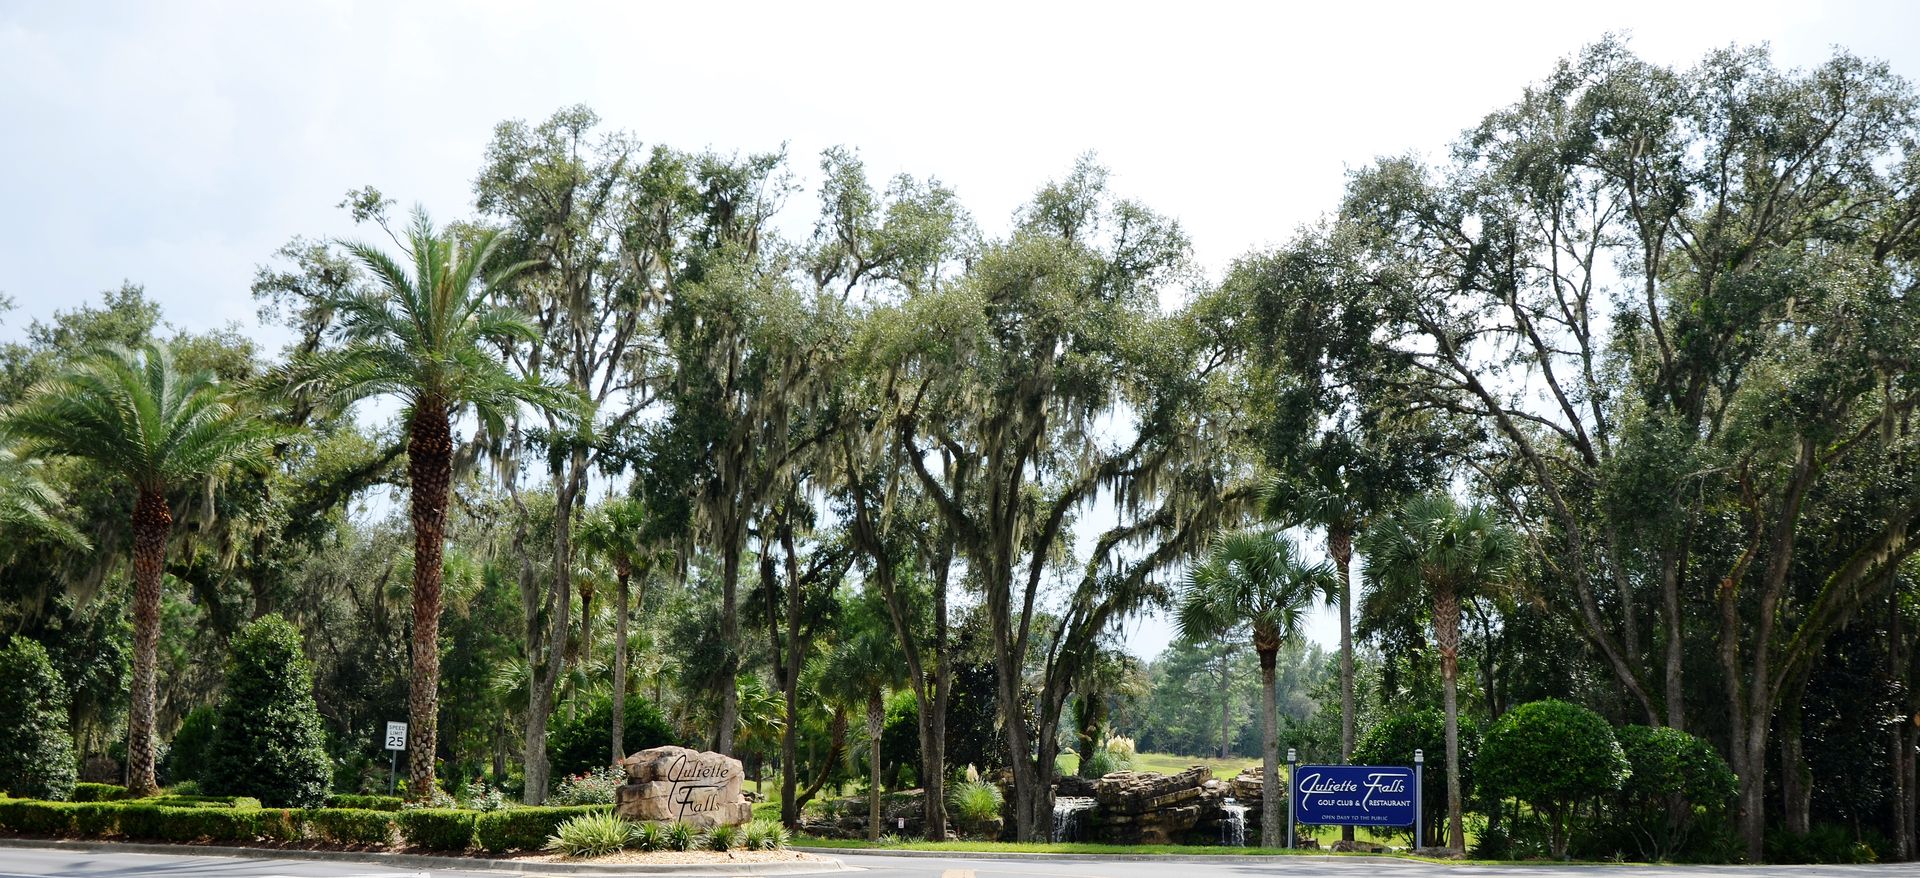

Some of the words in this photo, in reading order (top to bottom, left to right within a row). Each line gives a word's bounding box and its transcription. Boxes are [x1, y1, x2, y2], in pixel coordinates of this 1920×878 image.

[388, 736, 404, 747] 25
[668, 754, 729, 814] Juliette
[1300, 773, 1357, 811] Juliette
[1362, 773, 1408, 812] Falls
[676, 785, 720, 822] Falls
[1336, 799, 1353, 807] CLUB
